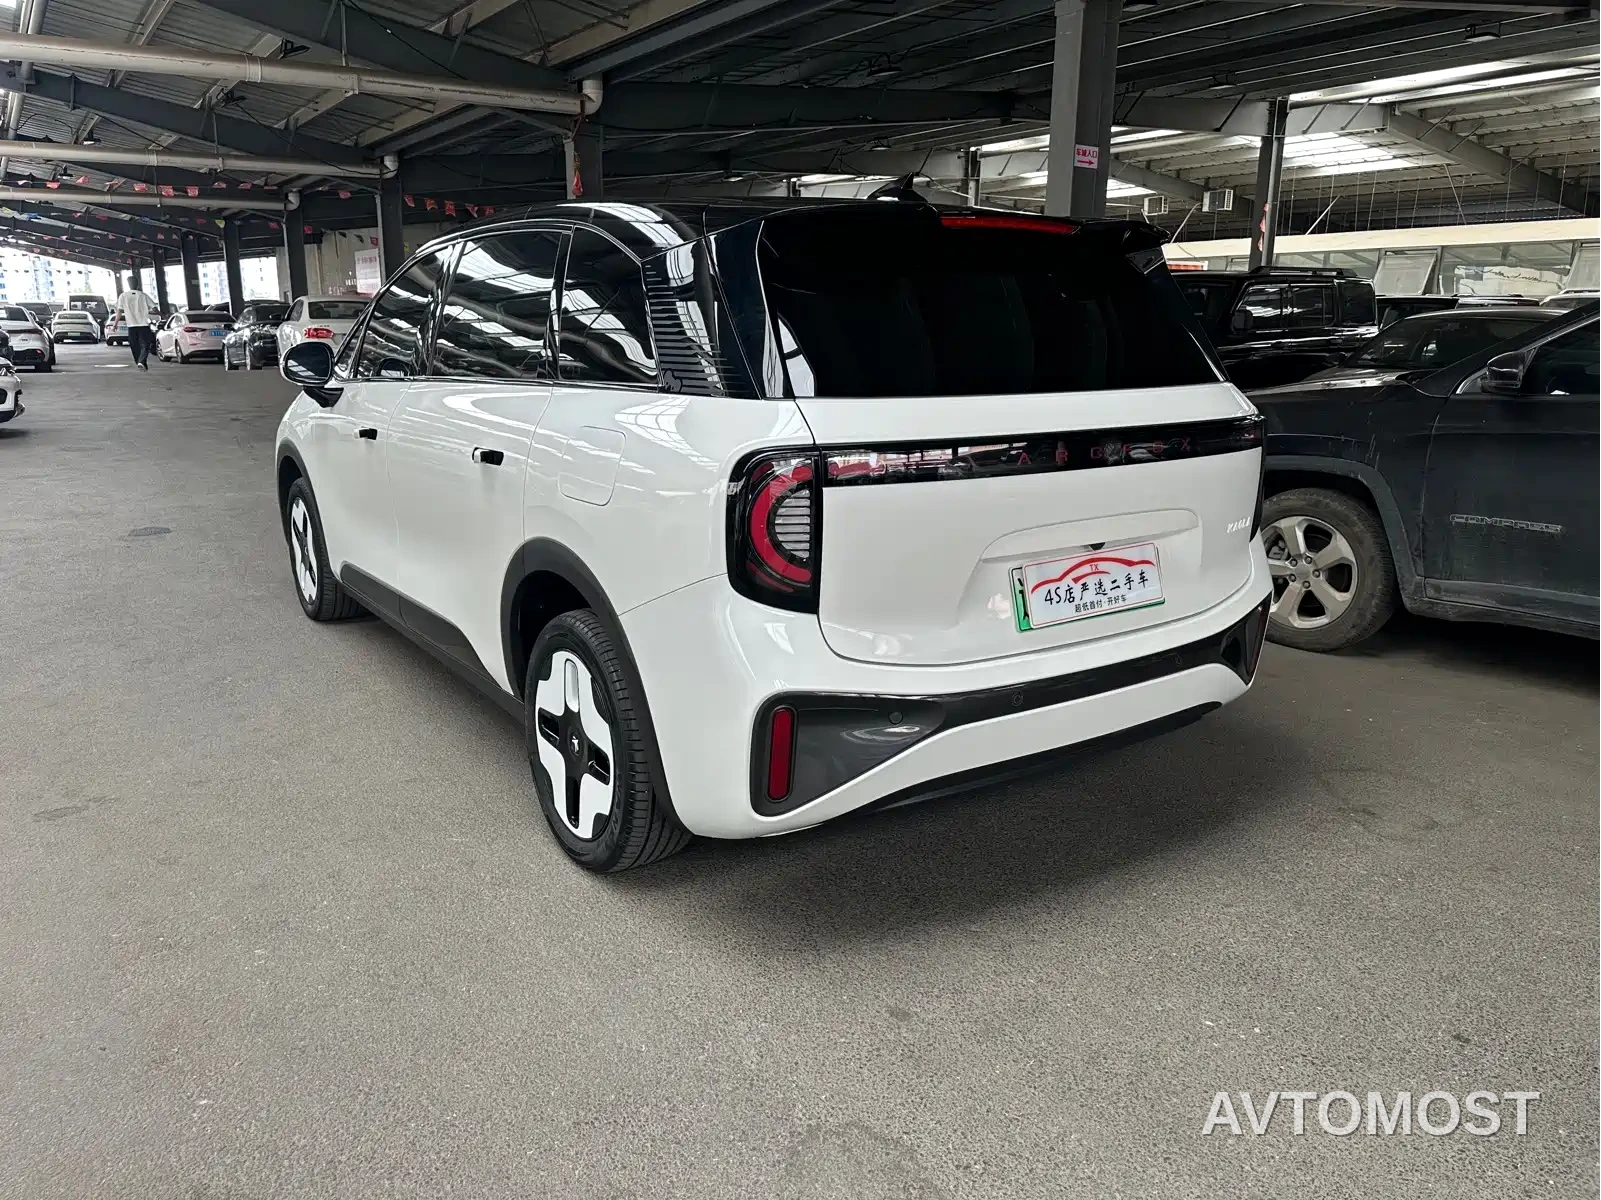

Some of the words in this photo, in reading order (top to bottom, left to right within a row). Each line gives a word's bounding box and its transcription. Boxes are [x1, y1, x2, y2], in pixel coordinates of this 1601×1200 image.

[1449, 513, 1563, 533] COMPASS
[1089, 563, 1100, 572] TX
[1044, 569, 1149, 606] 4S店严选二手车
